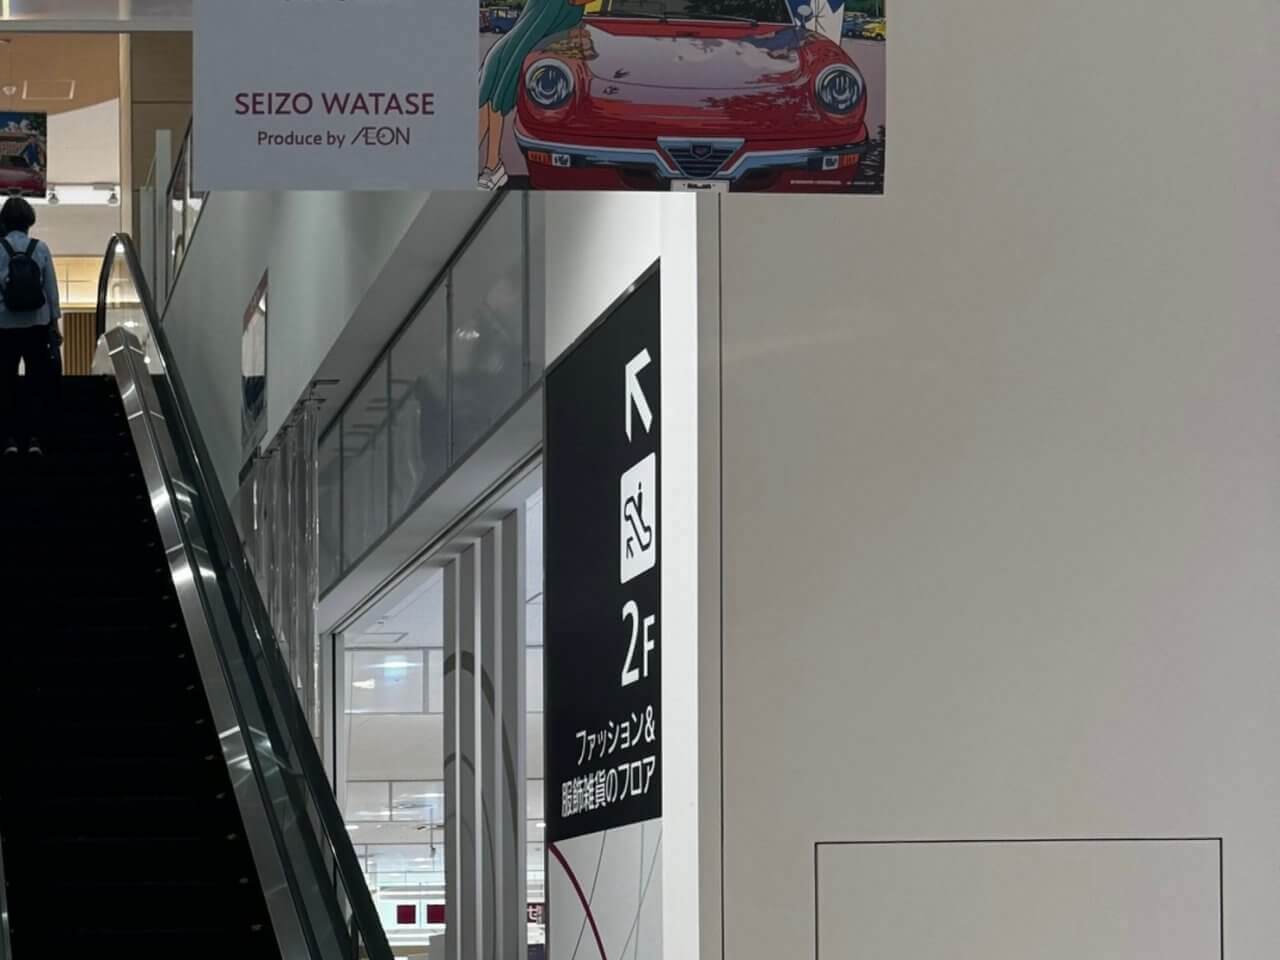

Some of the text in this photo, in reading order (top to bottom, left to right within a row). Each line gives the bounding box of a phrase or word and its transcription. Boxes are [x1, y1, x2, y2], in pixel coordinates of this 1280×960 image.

[235, 92, 435, 115] SEIZO WATASE
[257, 131, 322, 146] Produce
[326, 131, 346, 148] by
[621, 599, 655, 687] 2F
[576, 704, 656, 766] ファッション&
